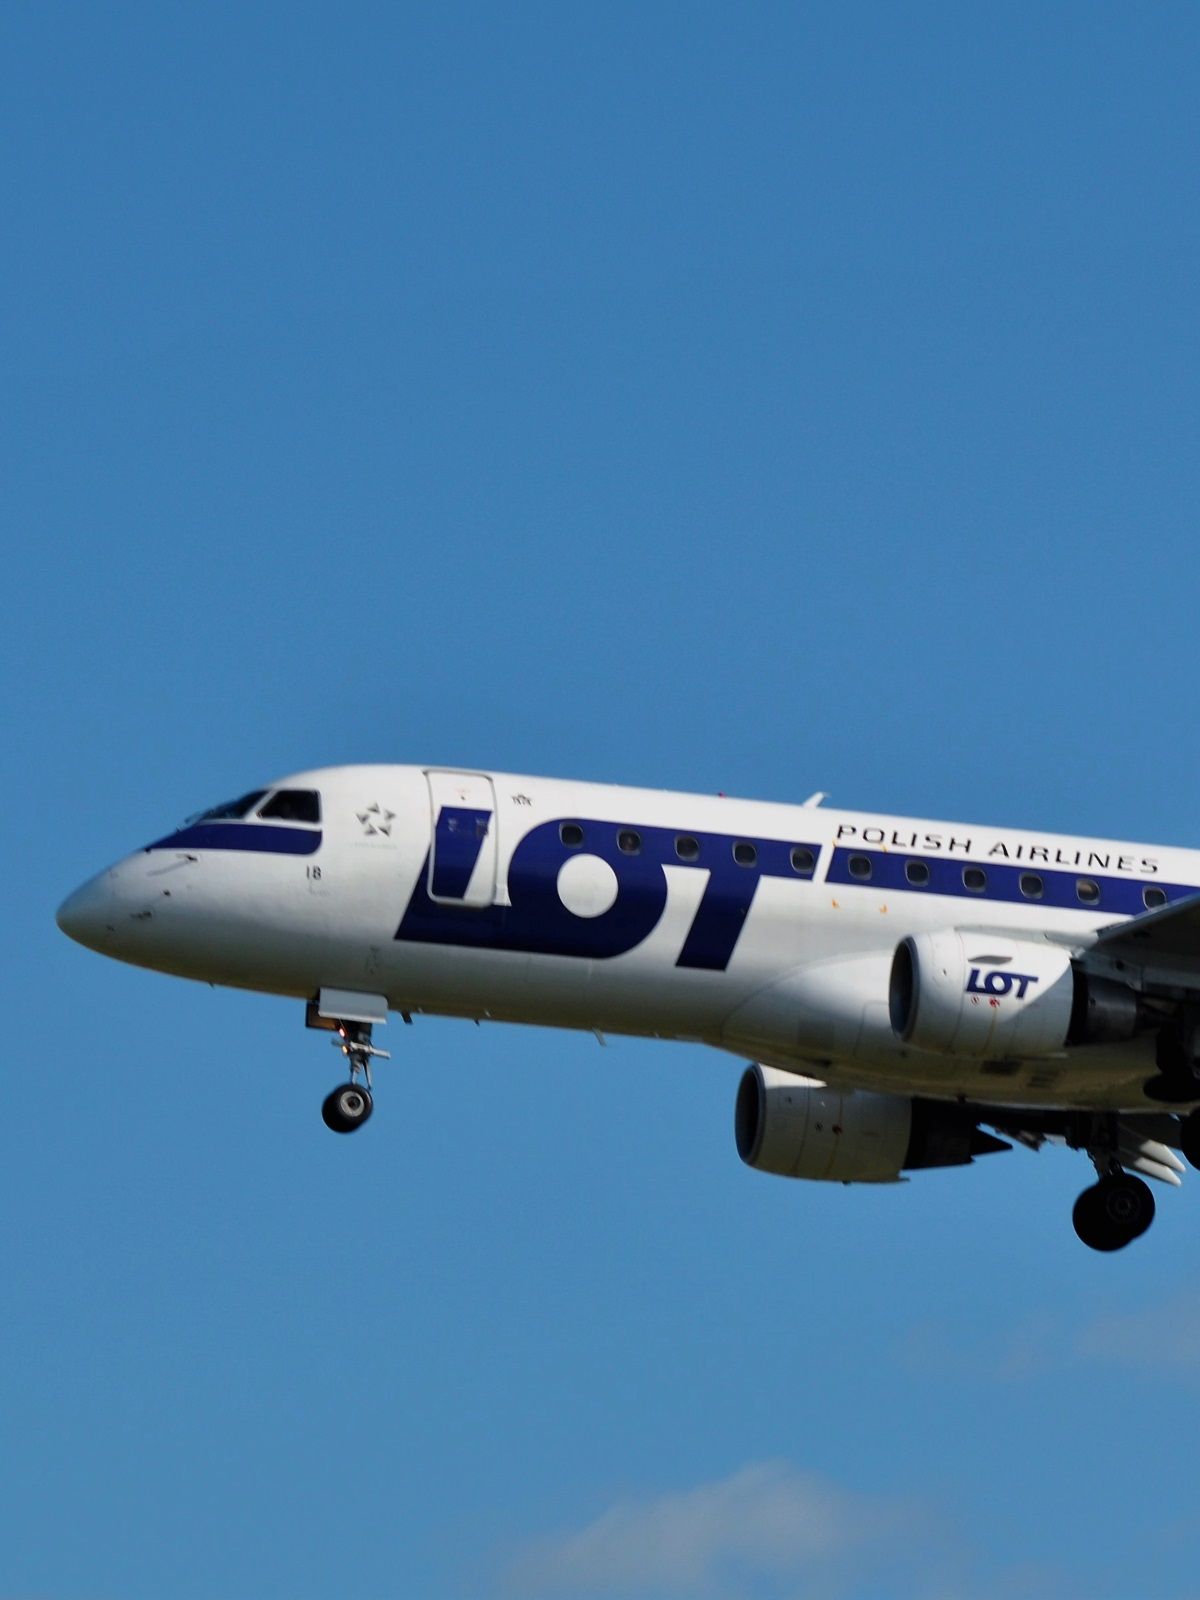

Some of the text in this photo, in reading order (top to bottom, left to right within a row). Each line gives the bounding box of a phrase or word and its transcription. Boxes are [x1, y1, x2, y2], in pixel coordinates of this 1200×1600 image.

[837, 824, 1159, 873] POLISH AIRLINES
[394, 806, 764, 972] LOT
[965, 968, 1039, 999] LOT
